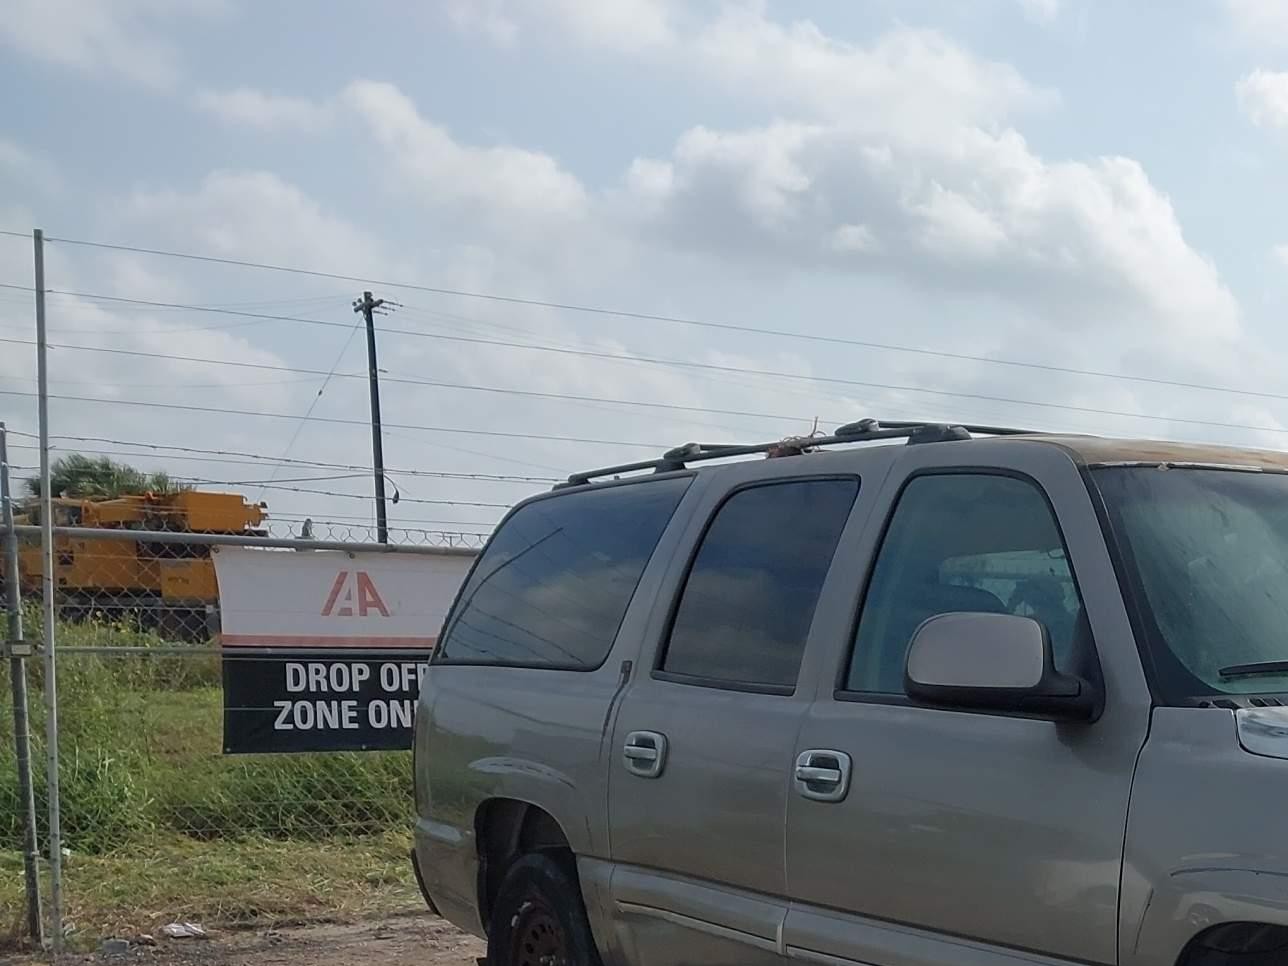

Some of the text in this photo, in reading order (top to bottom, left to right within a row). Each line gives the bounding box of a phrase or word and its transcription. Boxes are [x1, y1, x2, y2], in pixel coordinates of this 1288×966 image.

[285, 663, 370, 693] DROP
[273, 699, 419, 730] ZONE ON
